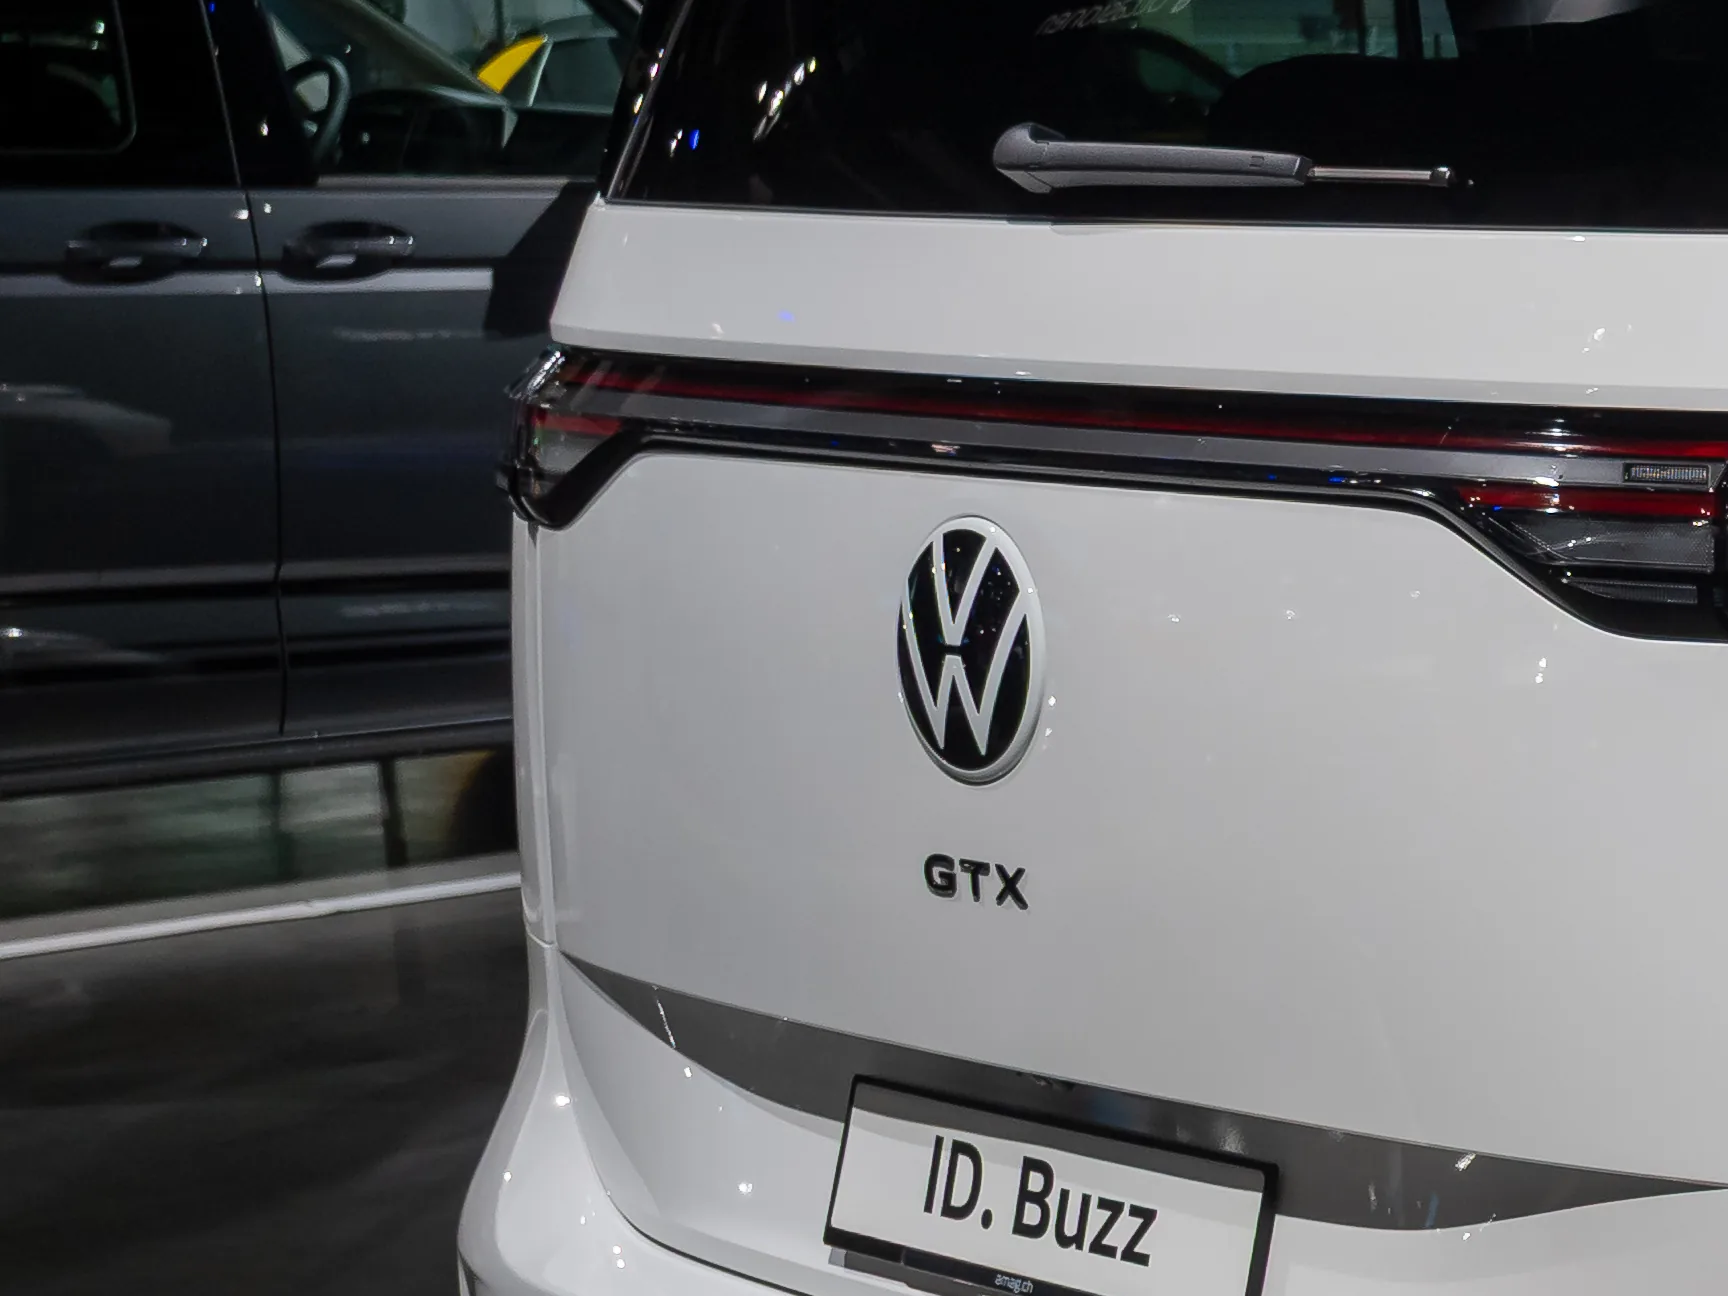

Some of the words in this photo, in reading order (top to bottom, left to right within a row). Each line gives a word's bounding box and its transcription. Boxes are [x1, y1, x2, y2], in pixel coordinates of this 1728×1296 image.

[922, 853, 1029, 912] GTX
[922, 1134, 994, 1231] ID.
[1011, 1154, 1159, 1268] Buzz
[994, 1274, 1035, 1295] amag.ch
